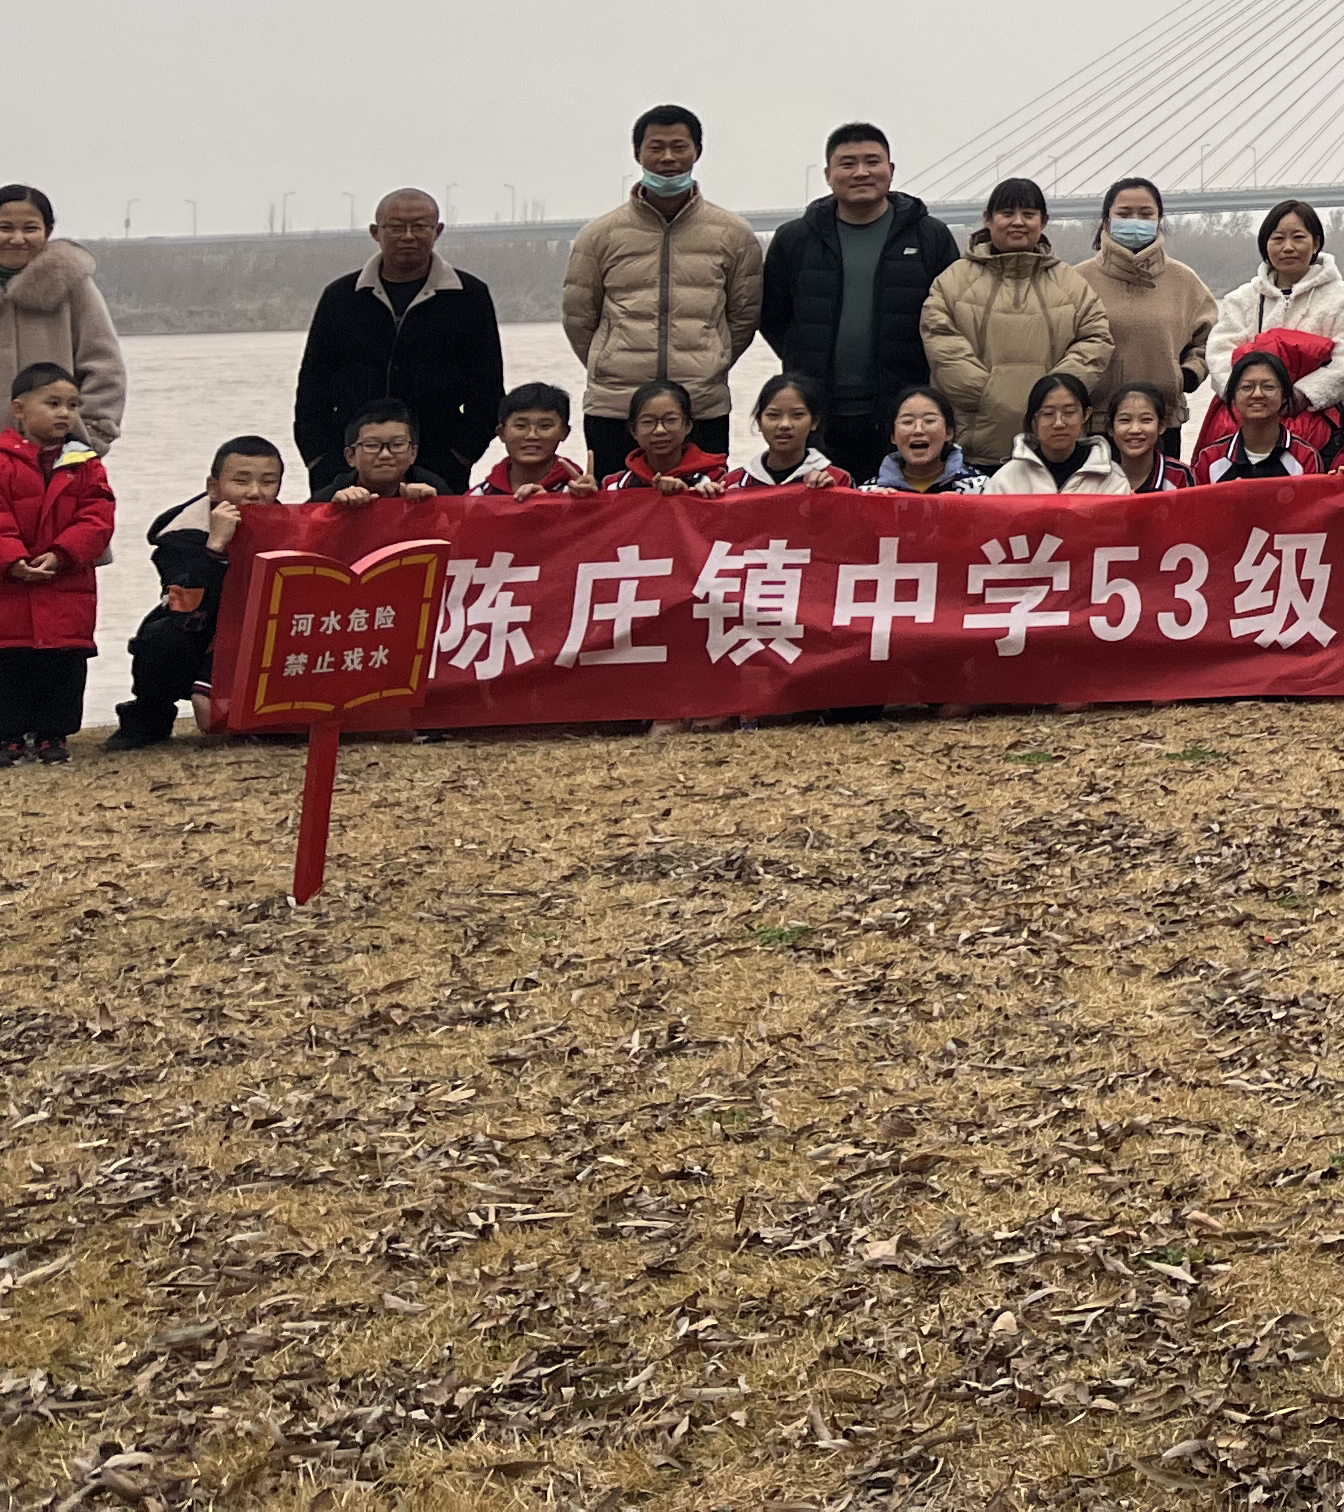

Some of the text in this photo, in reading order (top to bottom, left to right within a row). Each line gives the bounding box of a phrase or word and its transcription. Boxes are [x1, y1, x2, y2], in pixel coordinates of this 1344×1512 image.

[290, 605, 397, 636] 河水危险
[282, 644, 390, 677] 禁止戏水
